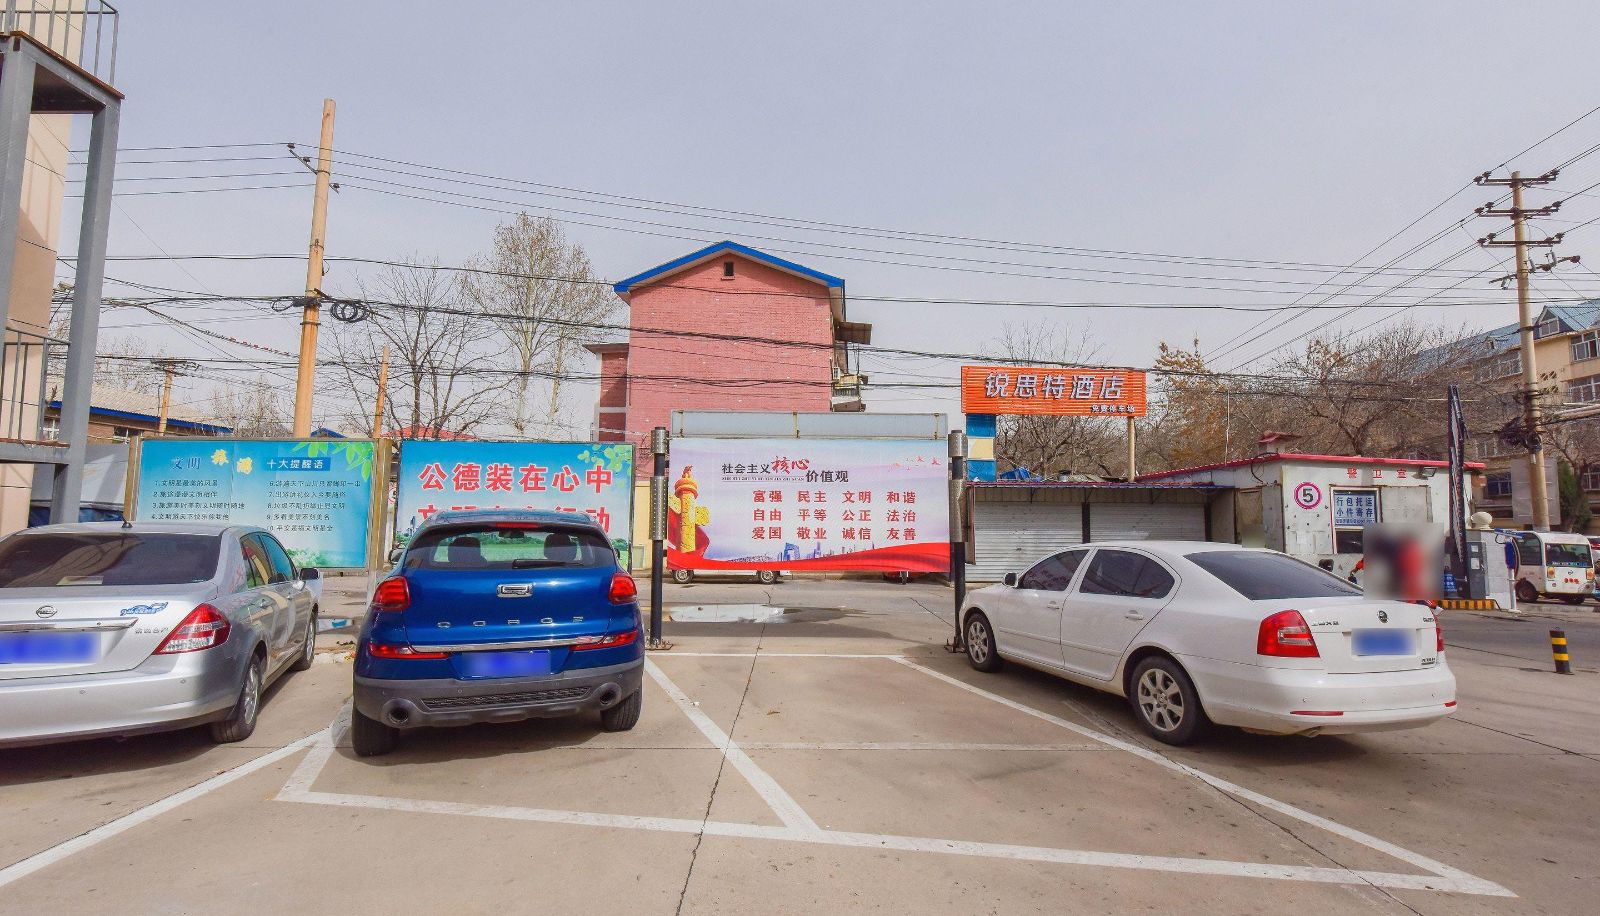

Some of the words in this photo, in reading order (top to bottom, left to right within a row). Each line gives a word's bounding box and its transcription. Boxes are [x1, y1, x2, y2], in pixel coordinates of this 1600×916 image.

[985, 372, 1124, 399] 锐思特酒店
[266, 457, 324, 470] 十大提醒语
[721, 463, 771, 474] 社会主义
[771, 456, 810, 474] 核心
[805, 470, 849, 483] 价值观
[418, 463, 613, 493] 公德装在心中
[752, 490, 783, 504] 富强
[796, 490, 827, 504] 民主
[841, 490, 872, 504] 文明
[886, 490, 917, 504] 和谐
[1302, 488, 1314, 503] 5
[1336, 496, 1373, 507] 行包托运
[752, 508, 783, 522] 自由
[796, 508, 827, 522] 平等
[841, 508, 872, 522] 公正
[886, 508, 917, 522] 法治
[1336, 507, 1373, 518] 小件寄存
[752, 526, 783, 541] 爱国
[796, 526, 827, 541] 敬业
[841, 526, 872, 541] 诚信
[886, 526, 917, 541] 友善
